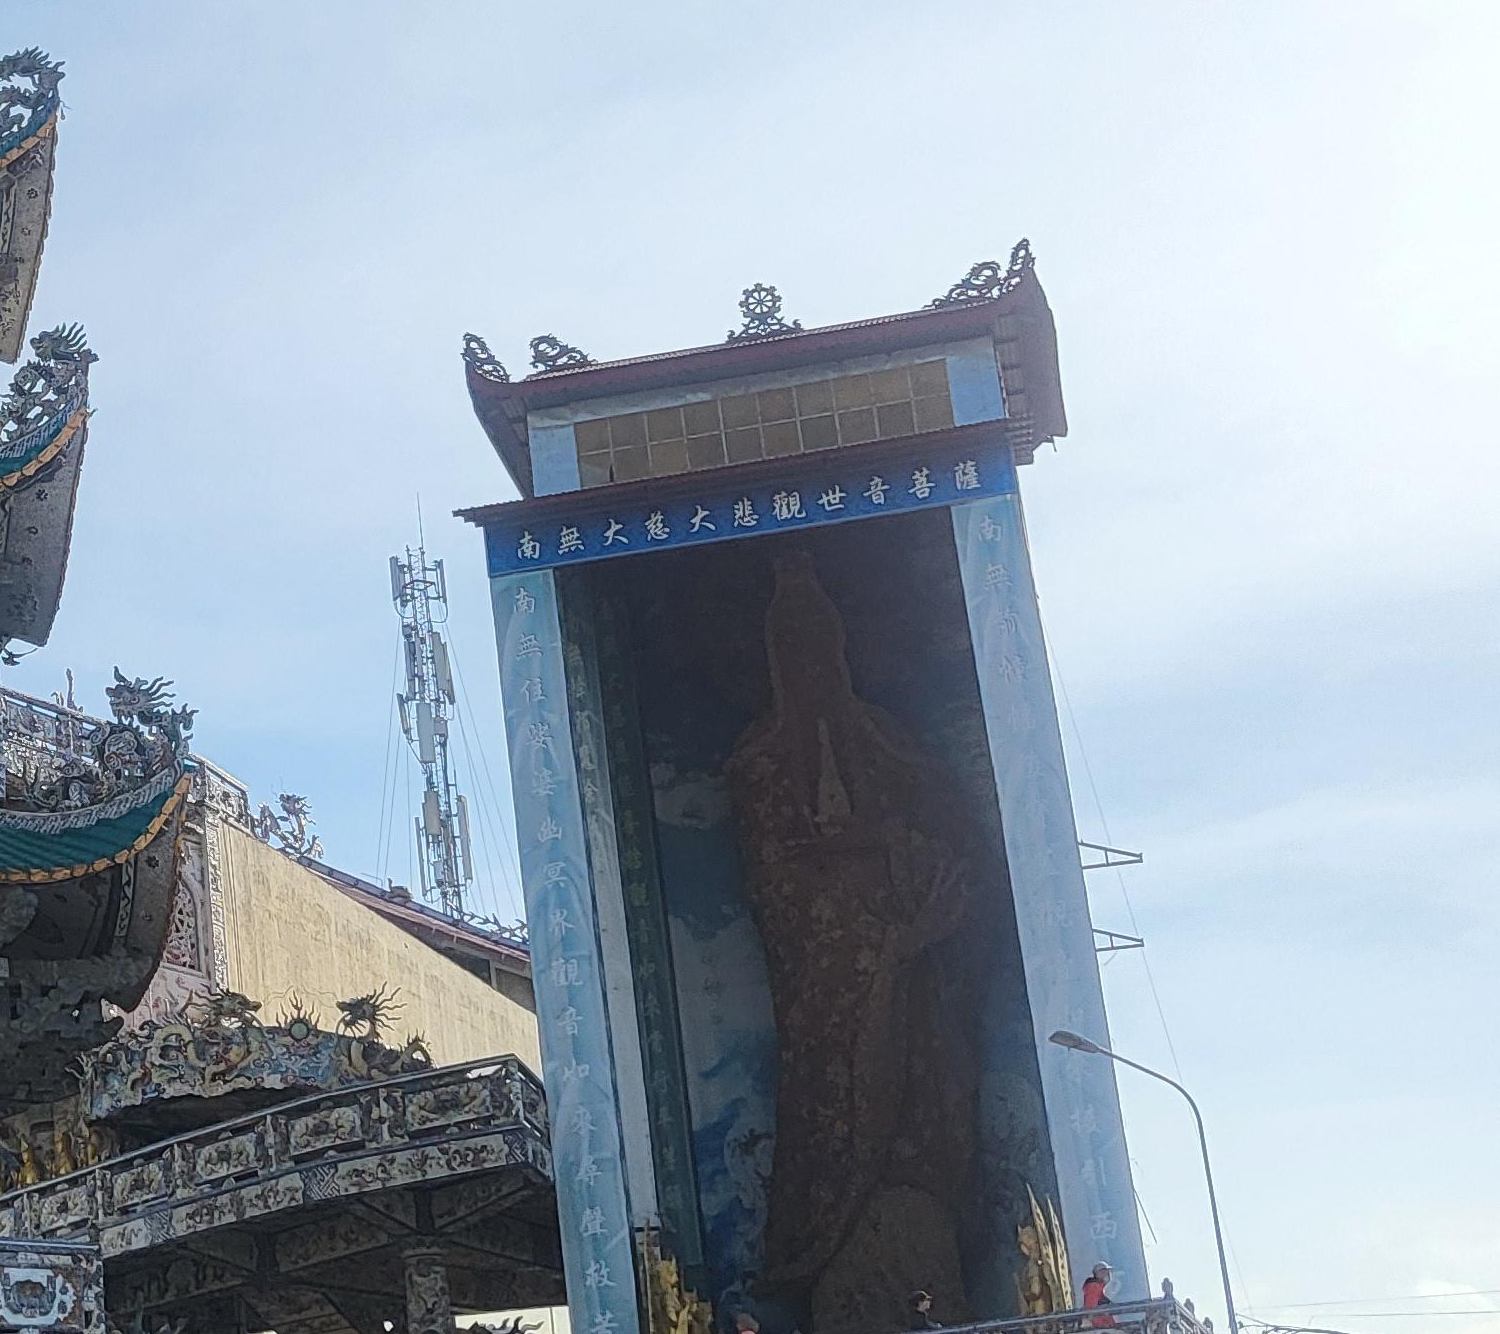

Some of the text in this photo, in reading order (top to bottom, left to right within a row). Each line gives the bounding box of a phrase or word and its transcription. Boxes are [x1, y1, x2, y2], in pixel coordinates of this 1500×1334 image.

[516, 460, 982, 560] 南無大慈大悲觀世音菩薩
